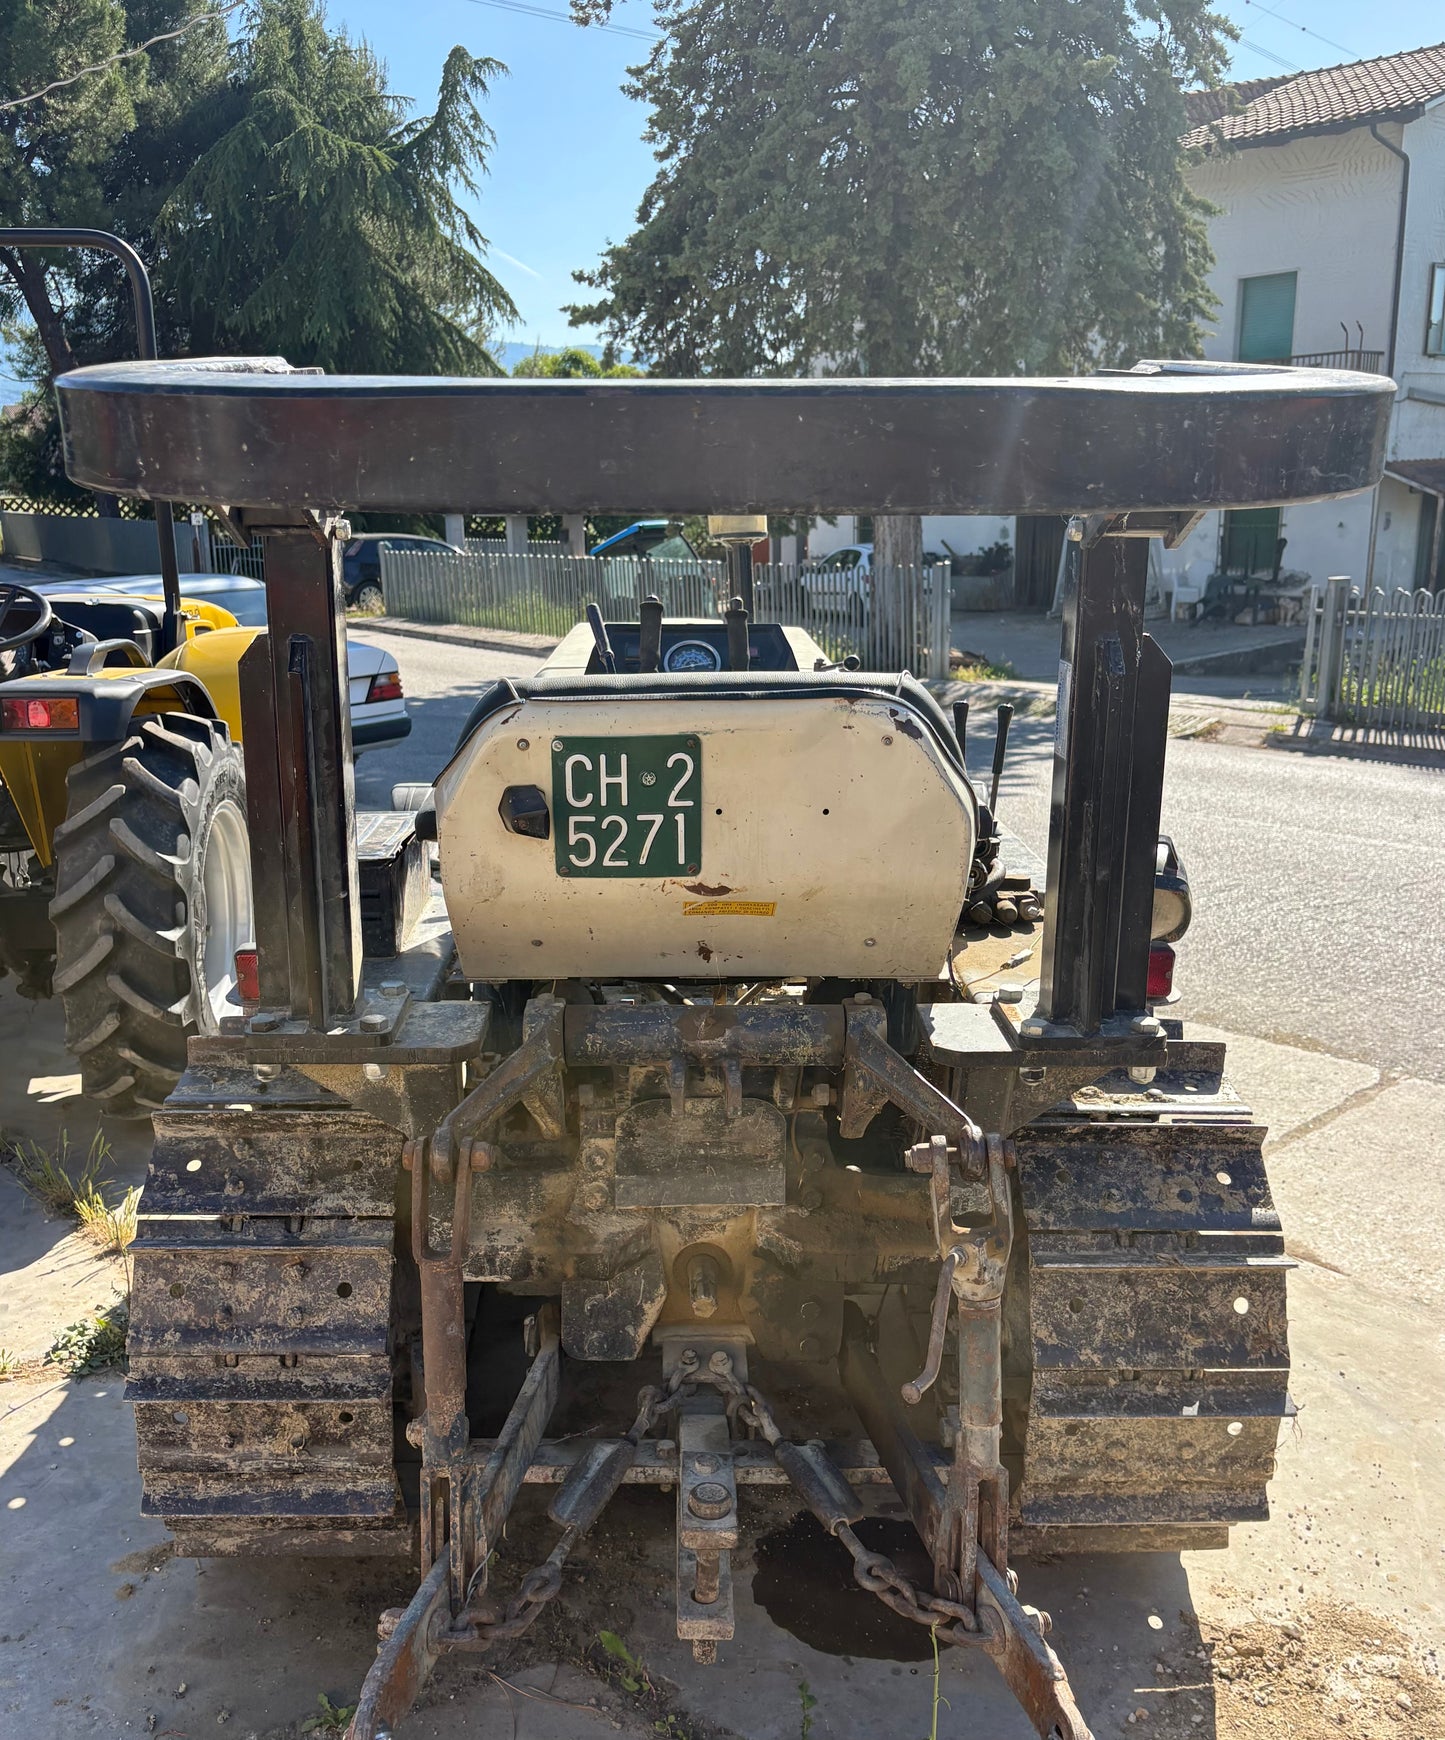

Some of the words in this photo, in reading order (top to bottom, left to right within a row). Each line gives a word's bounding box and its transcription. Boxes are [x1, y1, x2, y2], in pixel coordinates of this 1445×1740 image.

[565, 753, 629, 808] CH
[666, 752, 695, 807] 2
[568, 812, 686, 867] 5271
